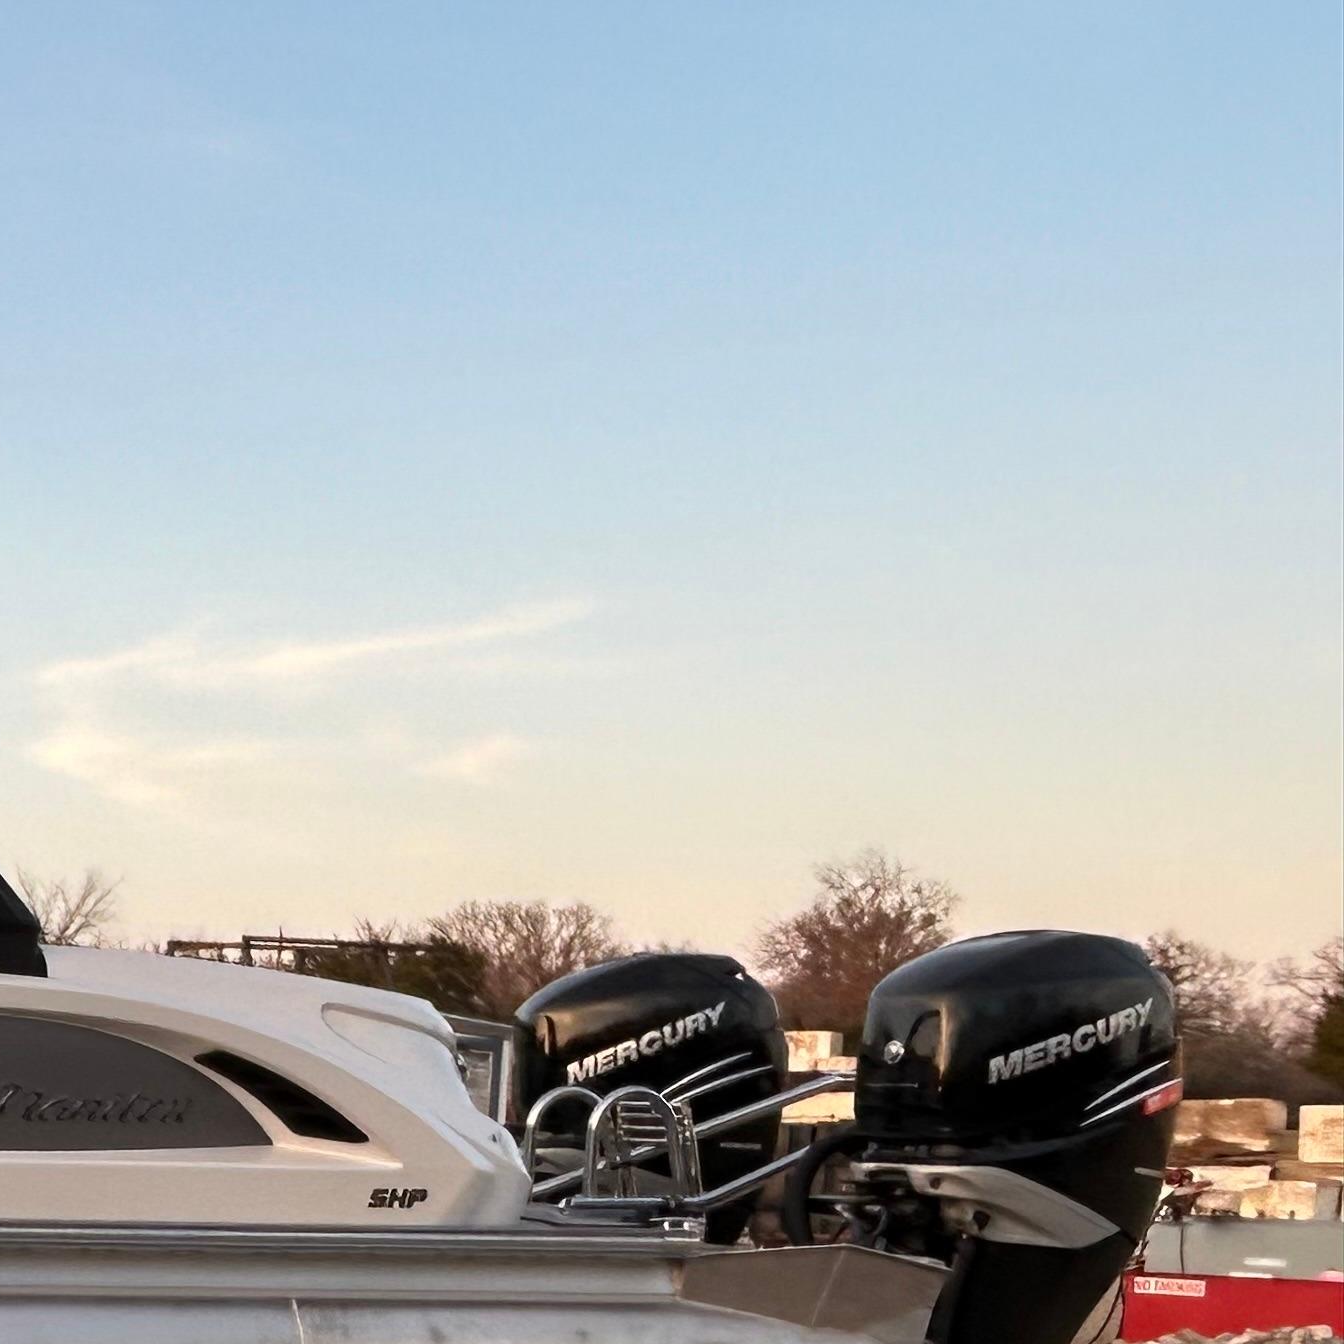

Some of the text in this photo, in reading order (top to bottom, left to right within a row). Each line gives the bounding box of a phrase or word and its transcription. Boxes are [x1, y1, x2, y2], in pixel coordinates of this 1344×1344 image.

[566, 1001, 726, 1086] MERCURY
[988, 997, 1153, 1084] MERCURY
[368, 1188, 428, 1209] SHP
